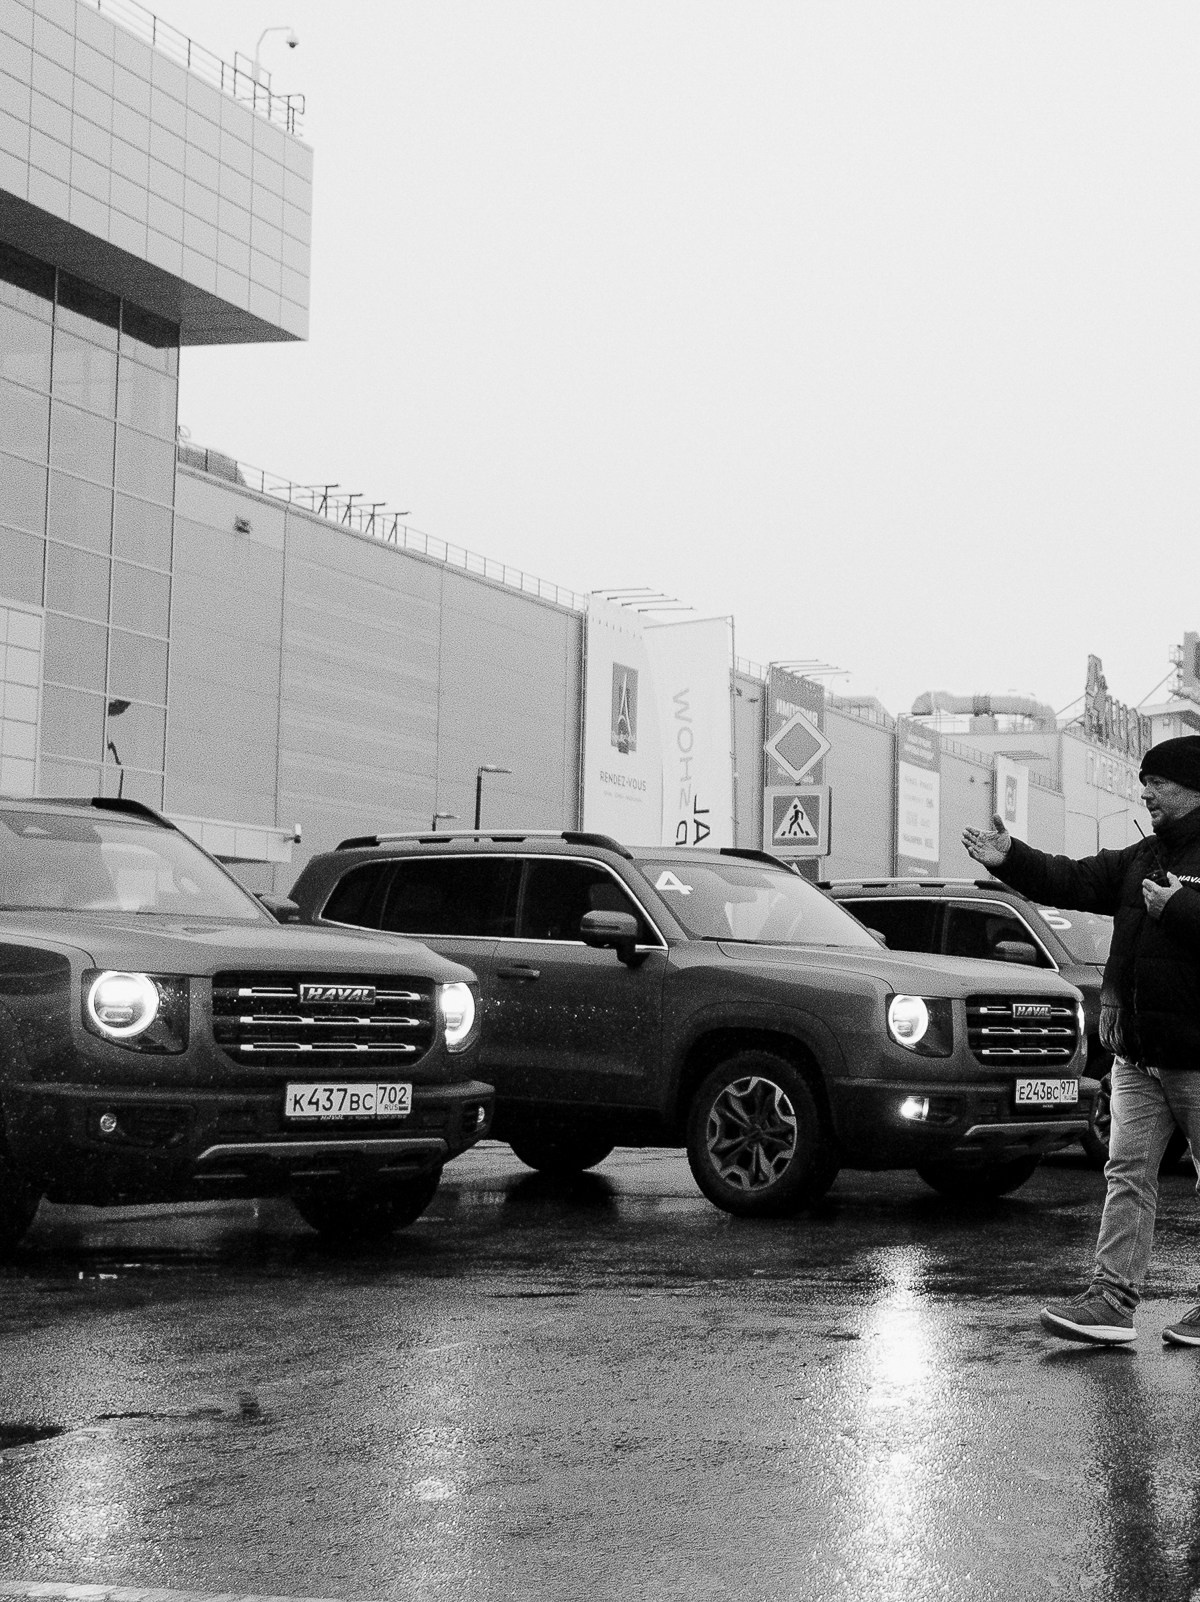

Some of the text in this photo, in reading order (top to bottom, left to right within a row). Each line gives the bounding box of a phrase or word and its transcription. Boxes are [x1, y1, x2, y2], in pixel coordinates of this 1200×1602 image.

[599, 770, 647, 791] RENDEZ-VOUS
[655, 870, 694, 895] 4
[1038, 909, 1072, 930] 5
[306, 987, 373, 1001] HAVAL
[1016, 1006, 1050, 1016] HAVAL
[379, 1086, 407, 1105] 702
[384, 1103, 399, 1111] RUS
